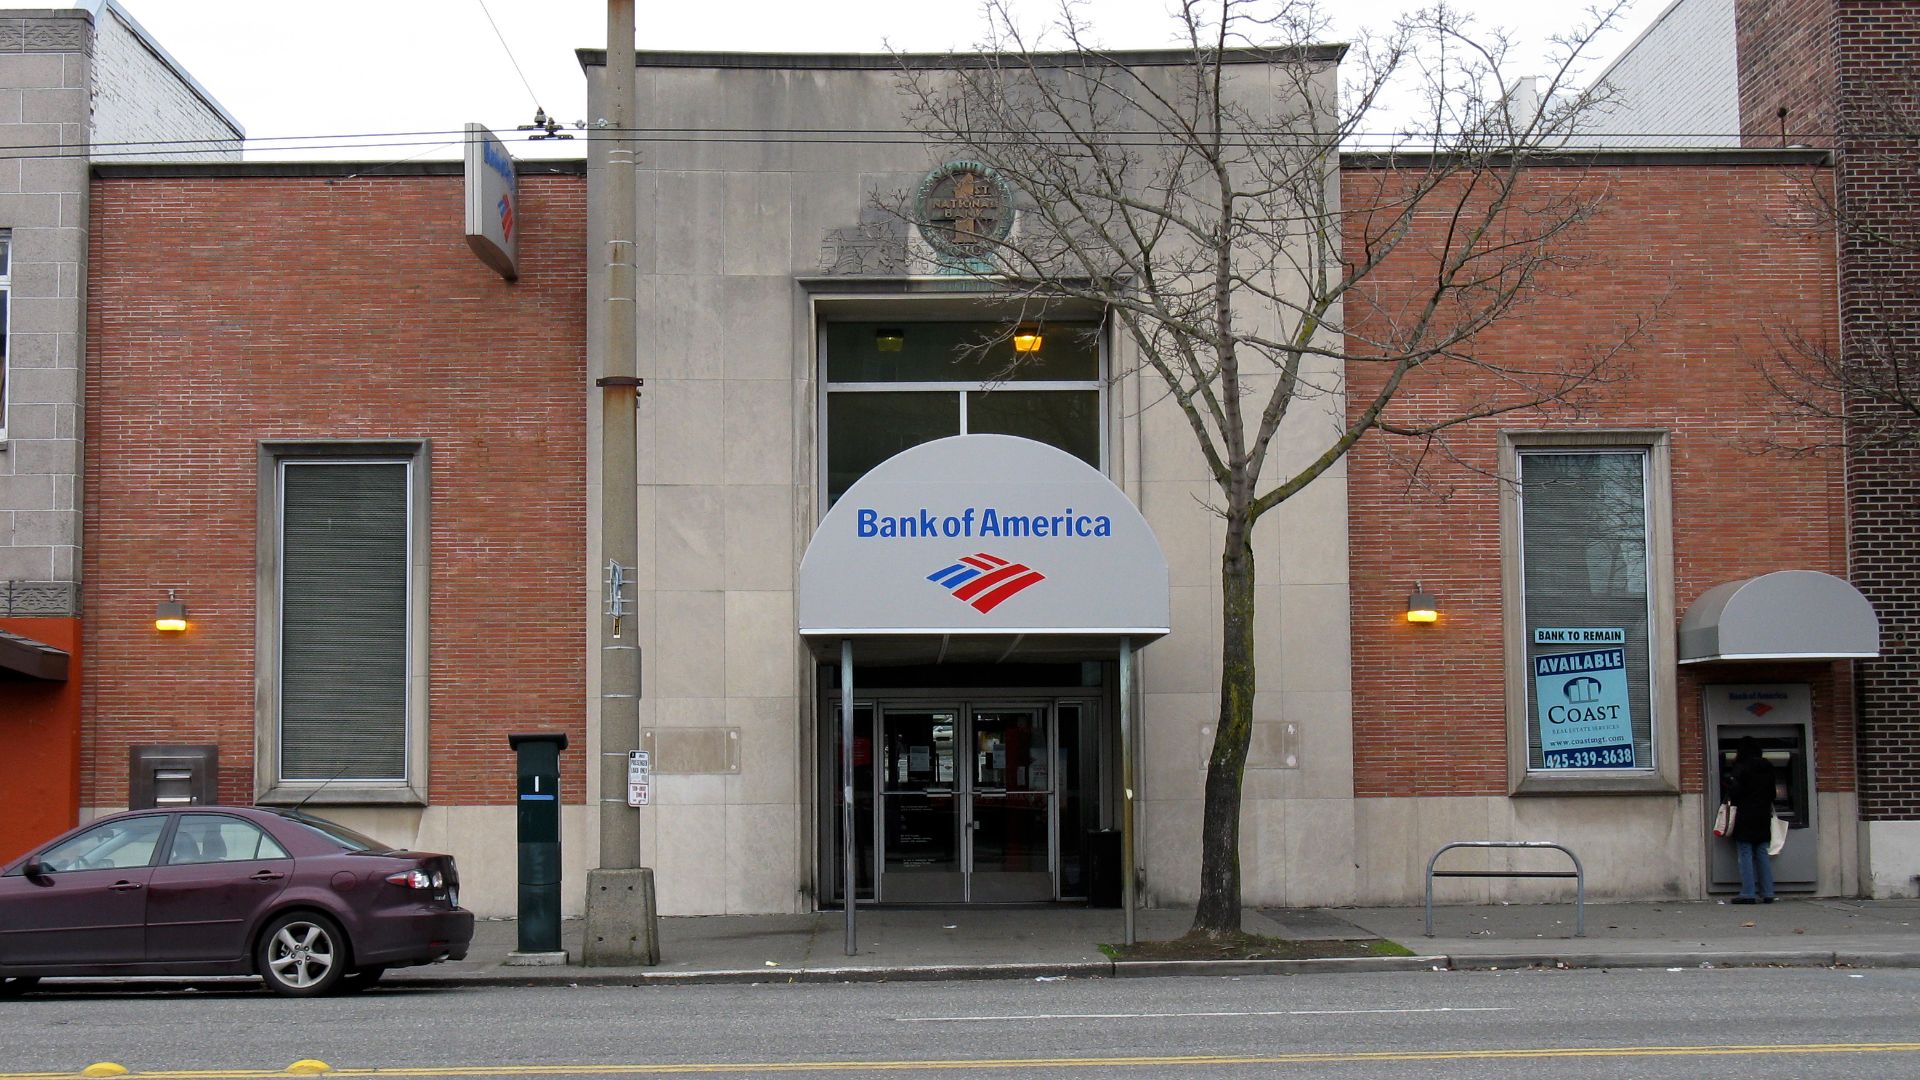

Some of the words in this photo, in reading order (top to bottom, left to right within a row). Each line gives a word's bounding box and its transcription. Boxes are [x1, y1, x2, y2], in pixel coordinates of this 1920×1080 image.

[933, 200, 998, 209] NATIONAL
[945, 208, 982, 218] BANK
[857, 508, 938, 538] Bank
[942, 508, 974, 538] of
[979, 508, 1111, 538] America
[1538, 631, 1564, 640] BANK
[1568, 631, 1580, 640] TO
[1583, 631, 1621, 641] REMAIN
[1538, 652, 1621, 674] AVAILABLE
[1546, 748, 1632, 768] 425-339-3638
